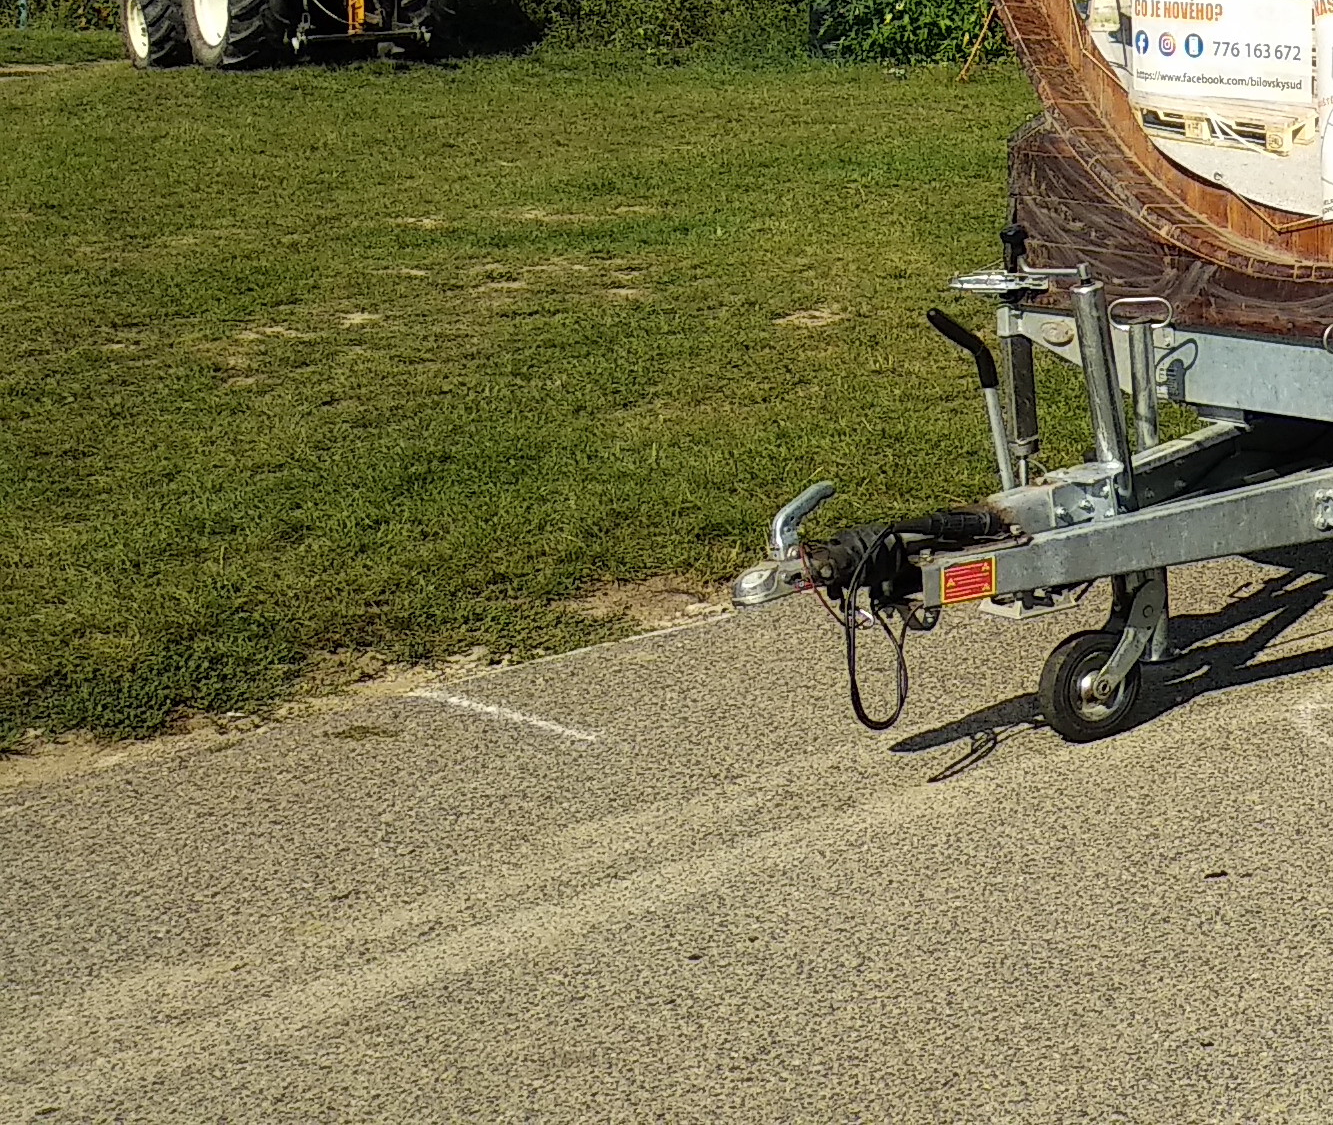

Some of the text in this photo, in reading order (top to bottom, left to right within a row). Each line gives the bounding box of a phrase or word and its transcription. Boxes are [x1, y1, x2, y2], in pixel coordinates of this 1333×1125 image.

[1150, 0, 1161, 18] JE
[1164, 0, 1223, 22] NOVÉHO?
[1212, 41, 1302, 61] 776 163 672
